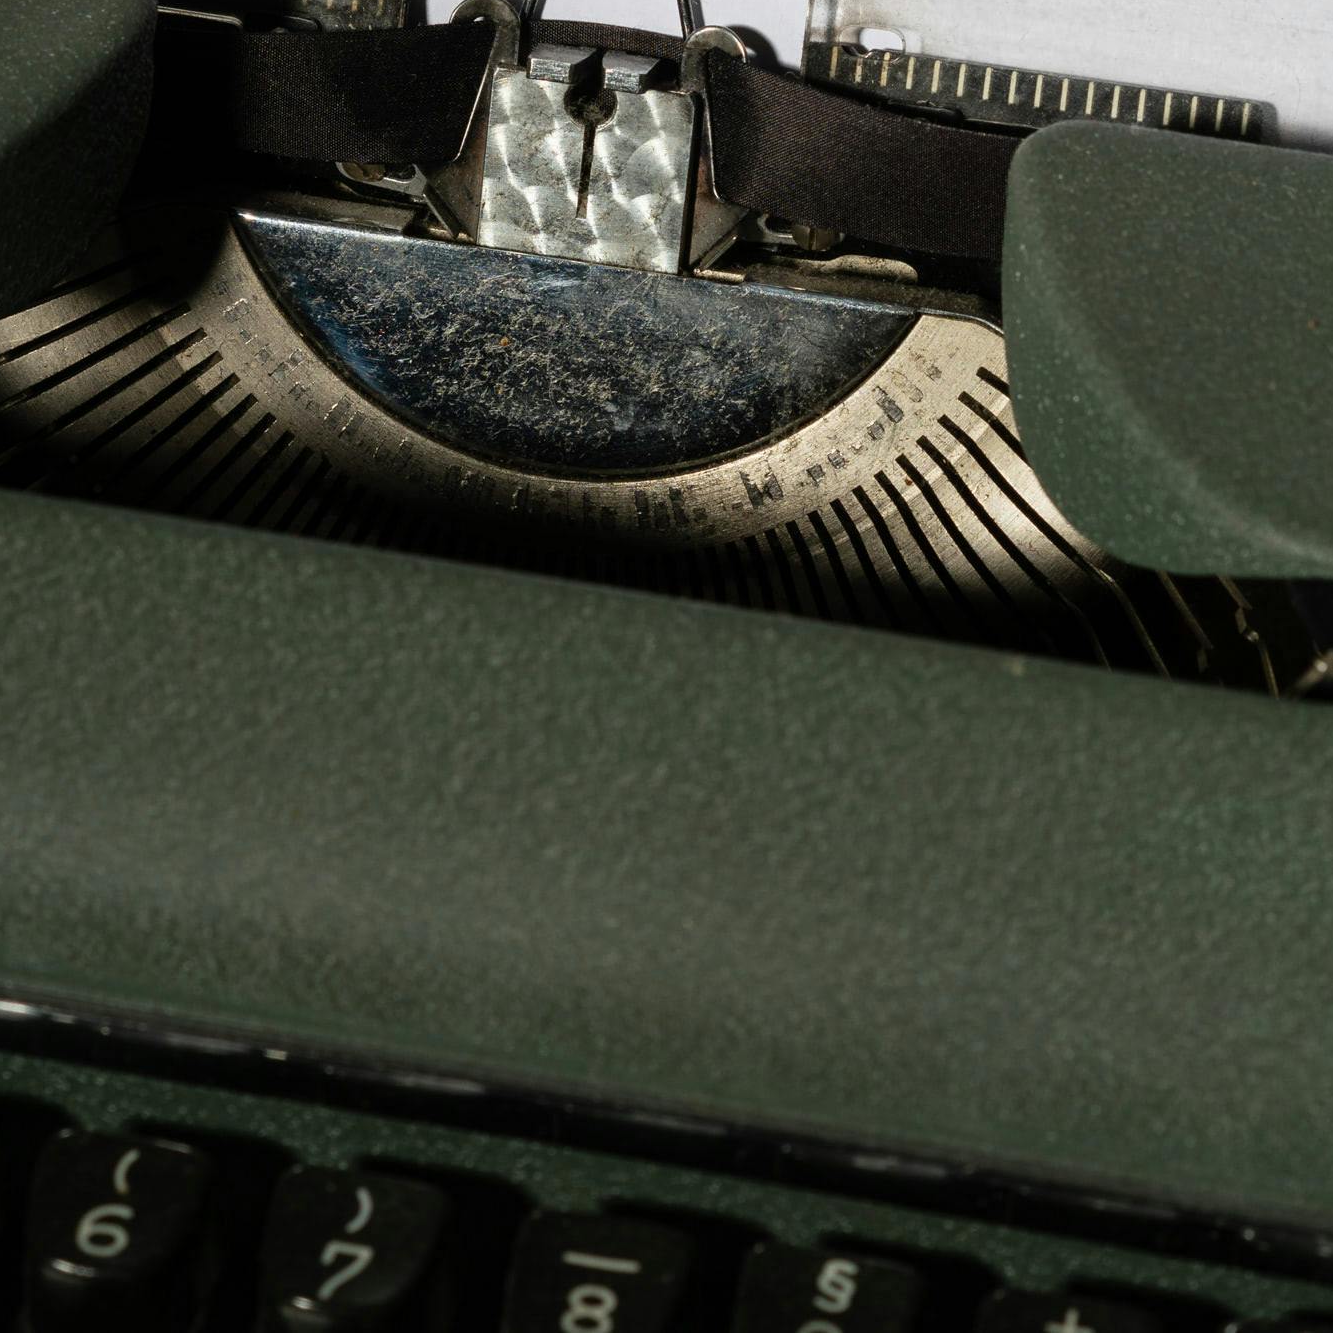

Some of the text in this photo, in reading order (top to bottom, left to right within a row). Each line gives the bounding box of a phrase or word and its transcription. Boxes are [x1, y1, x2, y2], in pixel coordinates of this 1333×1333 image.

[72, 1201, 137, 1261] 6
[315, 1237, 377, 1303] 7
[557, 1280, 621, 1333] 8
